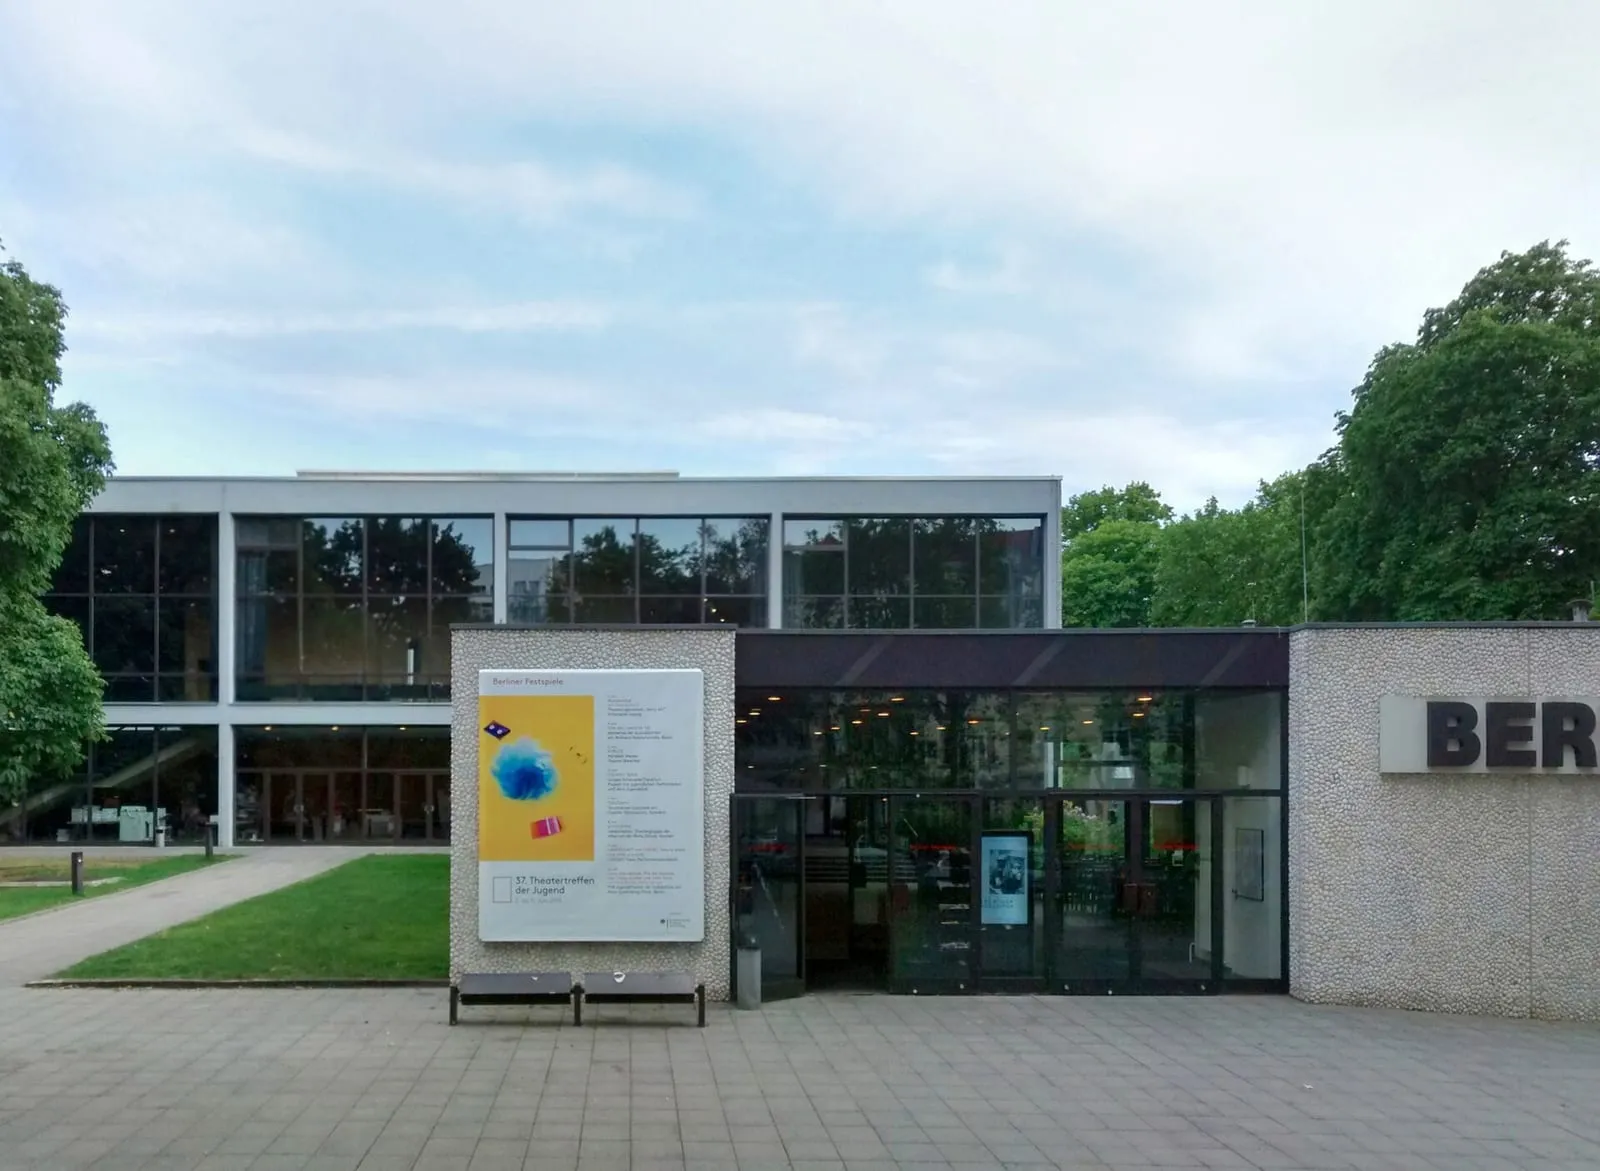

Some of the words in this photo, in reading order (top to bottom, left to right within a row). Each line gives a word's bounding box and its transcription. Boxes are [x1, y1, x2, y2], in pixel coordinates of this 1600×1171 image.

[492, 677, 523, 686] Berliner
[525, 677, 564, 688] Festspiele
[515, 876, 528, 885] 37.
[530, 876, 595, 885] Theatertreffen
[515, 886, 530, 895] der
[532, 886, 565, 896] Jugend
